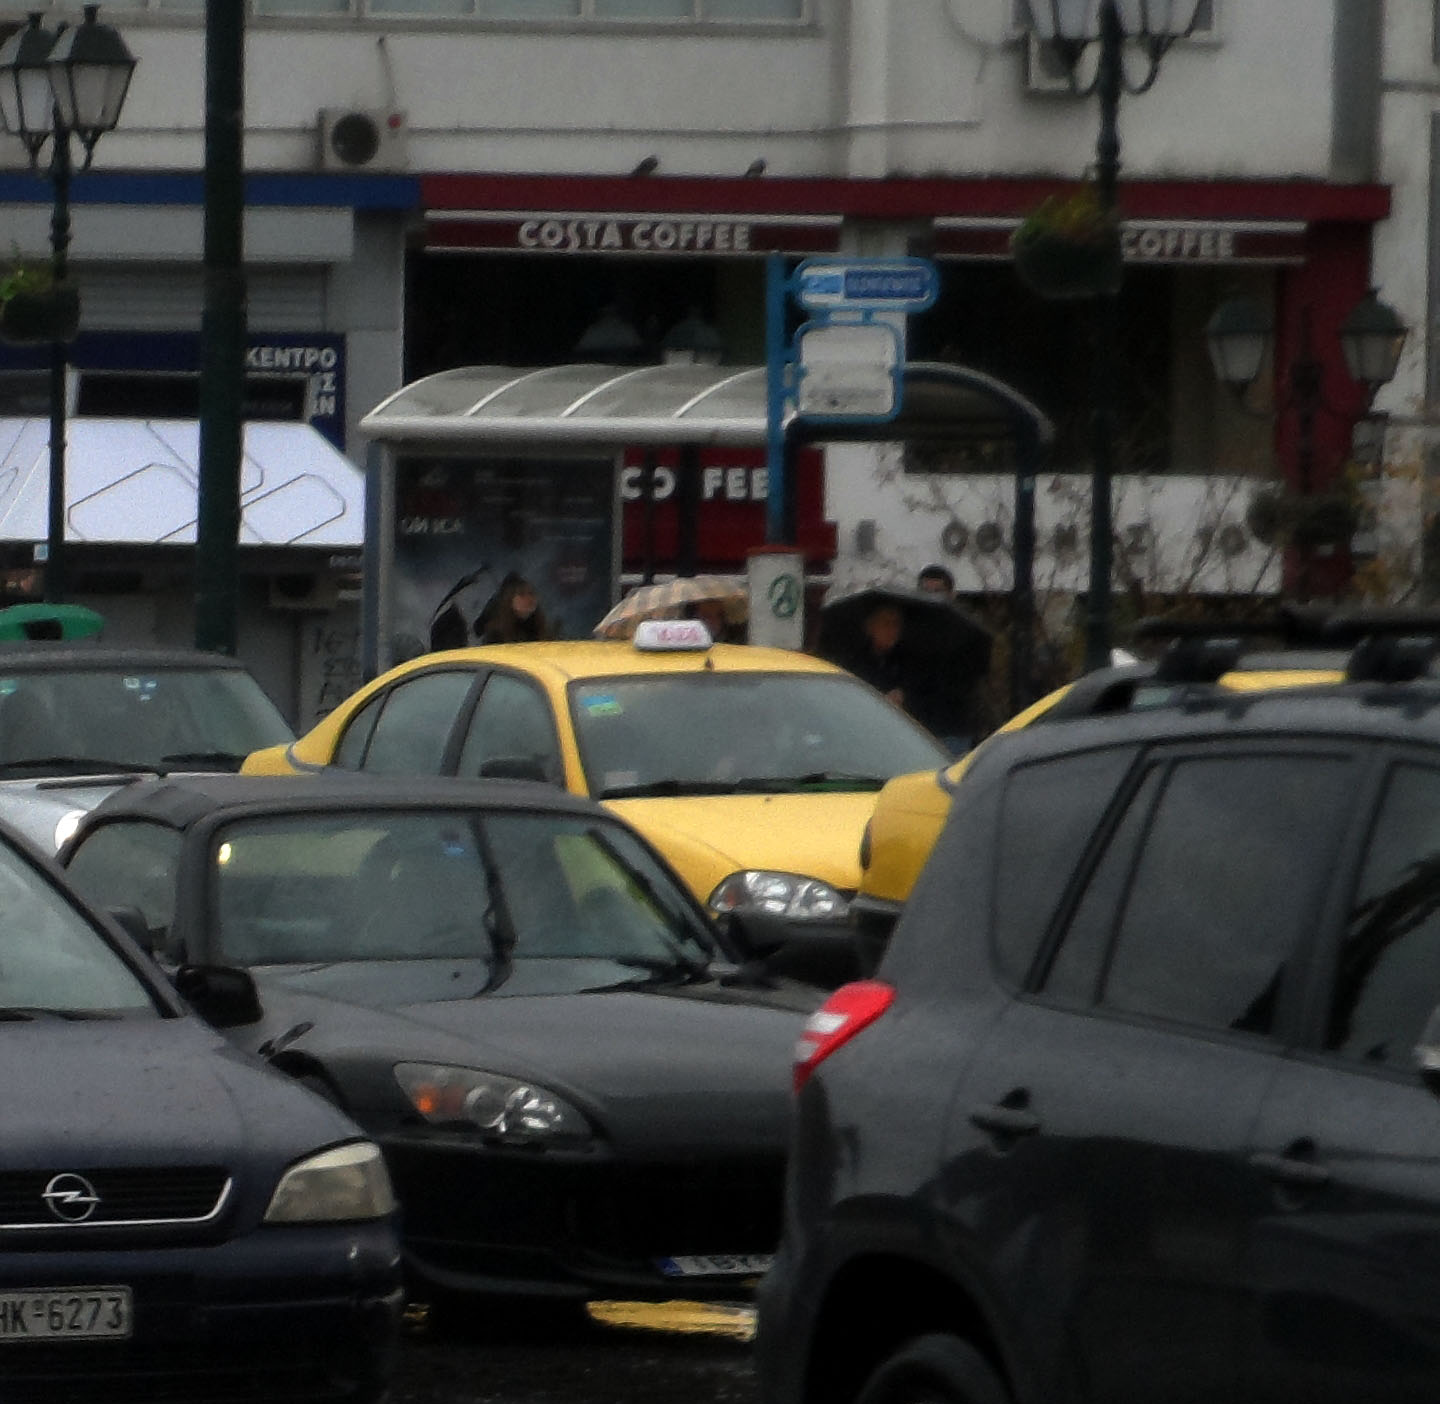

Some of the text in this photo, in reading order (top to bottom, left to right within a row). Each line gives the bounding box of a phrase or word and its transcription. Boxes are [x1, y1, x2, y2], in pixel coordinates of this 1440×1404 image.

[518, 221, 750, 251] COSTA COFFEE
[1122, 231, 1233, 258] COFFEE
